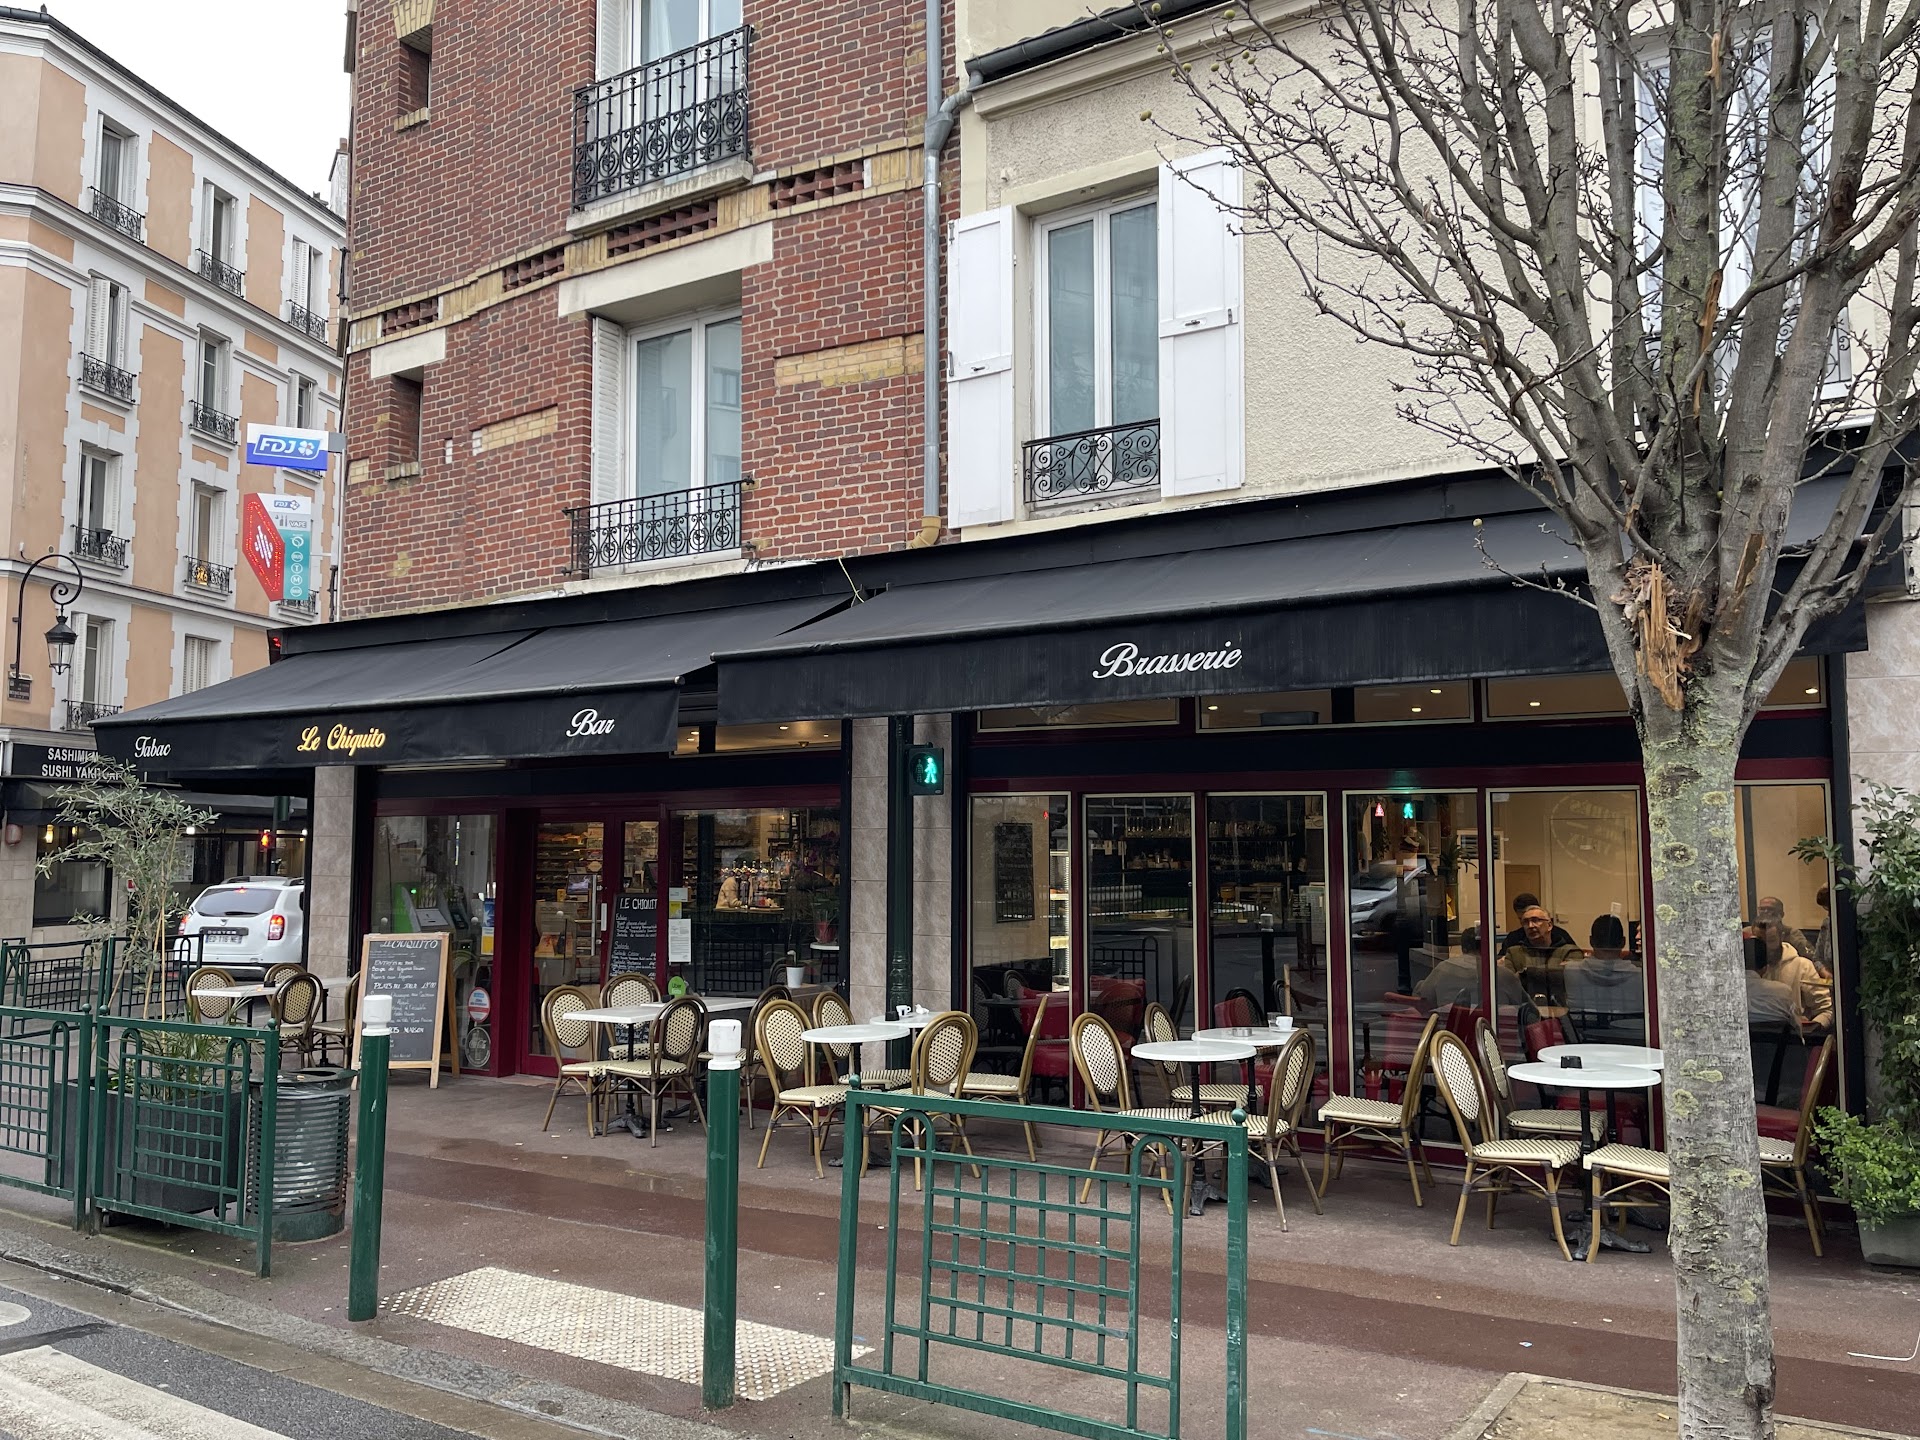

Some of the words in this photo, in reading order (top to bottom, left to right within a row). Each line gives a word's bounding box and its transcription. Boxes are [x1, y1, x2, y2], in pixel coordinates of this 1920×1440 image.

[259, 437, 297, 454] FDJ
[289, 520, 307, 529] VAPE
[1092, 640, 1243, 679] Brasserie
[566, 708, 615, 737] Bar
[134, 736, 171, 758] Tabac
[296, 725, 321, 752] Le
[326, 723, 386, 757] Chiquito
[41, 763, 72, 778] SUSHI
[620, 897, 630, 910] LE
